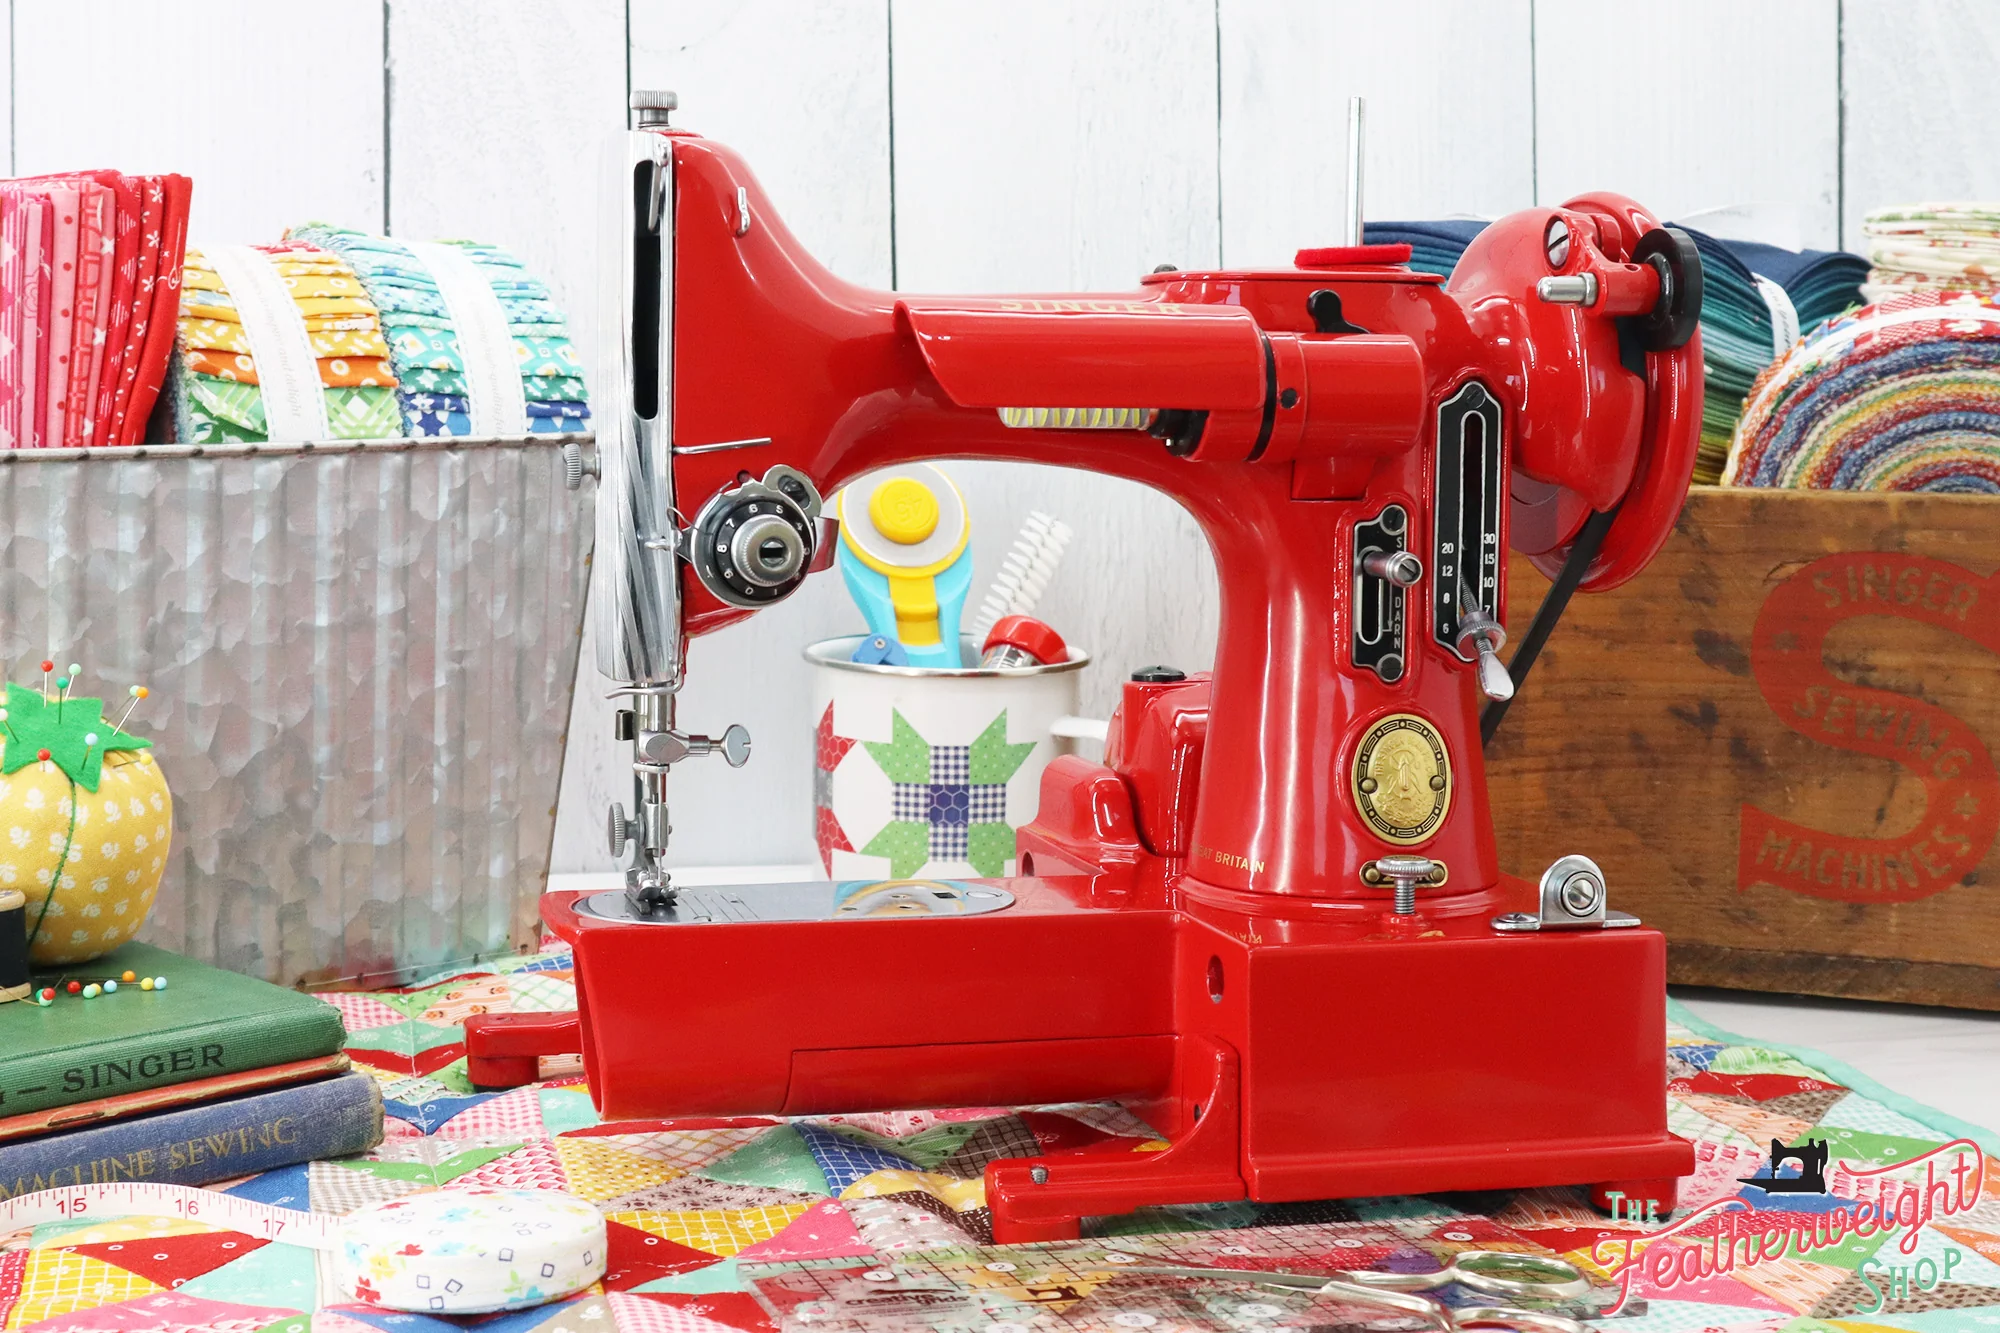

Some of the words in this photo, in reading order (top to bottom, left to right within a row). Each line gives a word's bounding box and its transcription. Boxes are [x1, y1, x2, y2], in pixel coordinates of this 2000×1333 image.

[1000, 300, 1184, 314] SINGER
[748, 503, 759, 513] 6
[775, 504, 784, 514] 5
[725, 518, 736, 529] 7
[1483, 533, 1496, 545] 30
[716, 544, 728, 553] 8
[1441, 542, 1454, 554] 20
[1484, 553, 1495, 565] 15
[1442, 565, 1453, 577] 12
[1483, 577, 1495, 588] 10
[1443, 593, 1451, 604] 8
[1812, 563, 1979, 622] SINGER
[1393, 596, 1402, 649] DARN
[1442, 622, 1450, 634] 6
[1792, 685, 1973, 782] SEWING
[1215, 851, 1265, 873] BRITAIN
[1756, 825, 1972, 891] MACHINES
[62, 1043, 225, 1093] SINGER
[170, 1116, 298, 1171] SEWING
[56, 1198, 88, 1214] 15
[175, 1198, 199, 1215] 16
[263, 1218, 286, 1236] 17
[845, 1293, 935, 1306] creative
